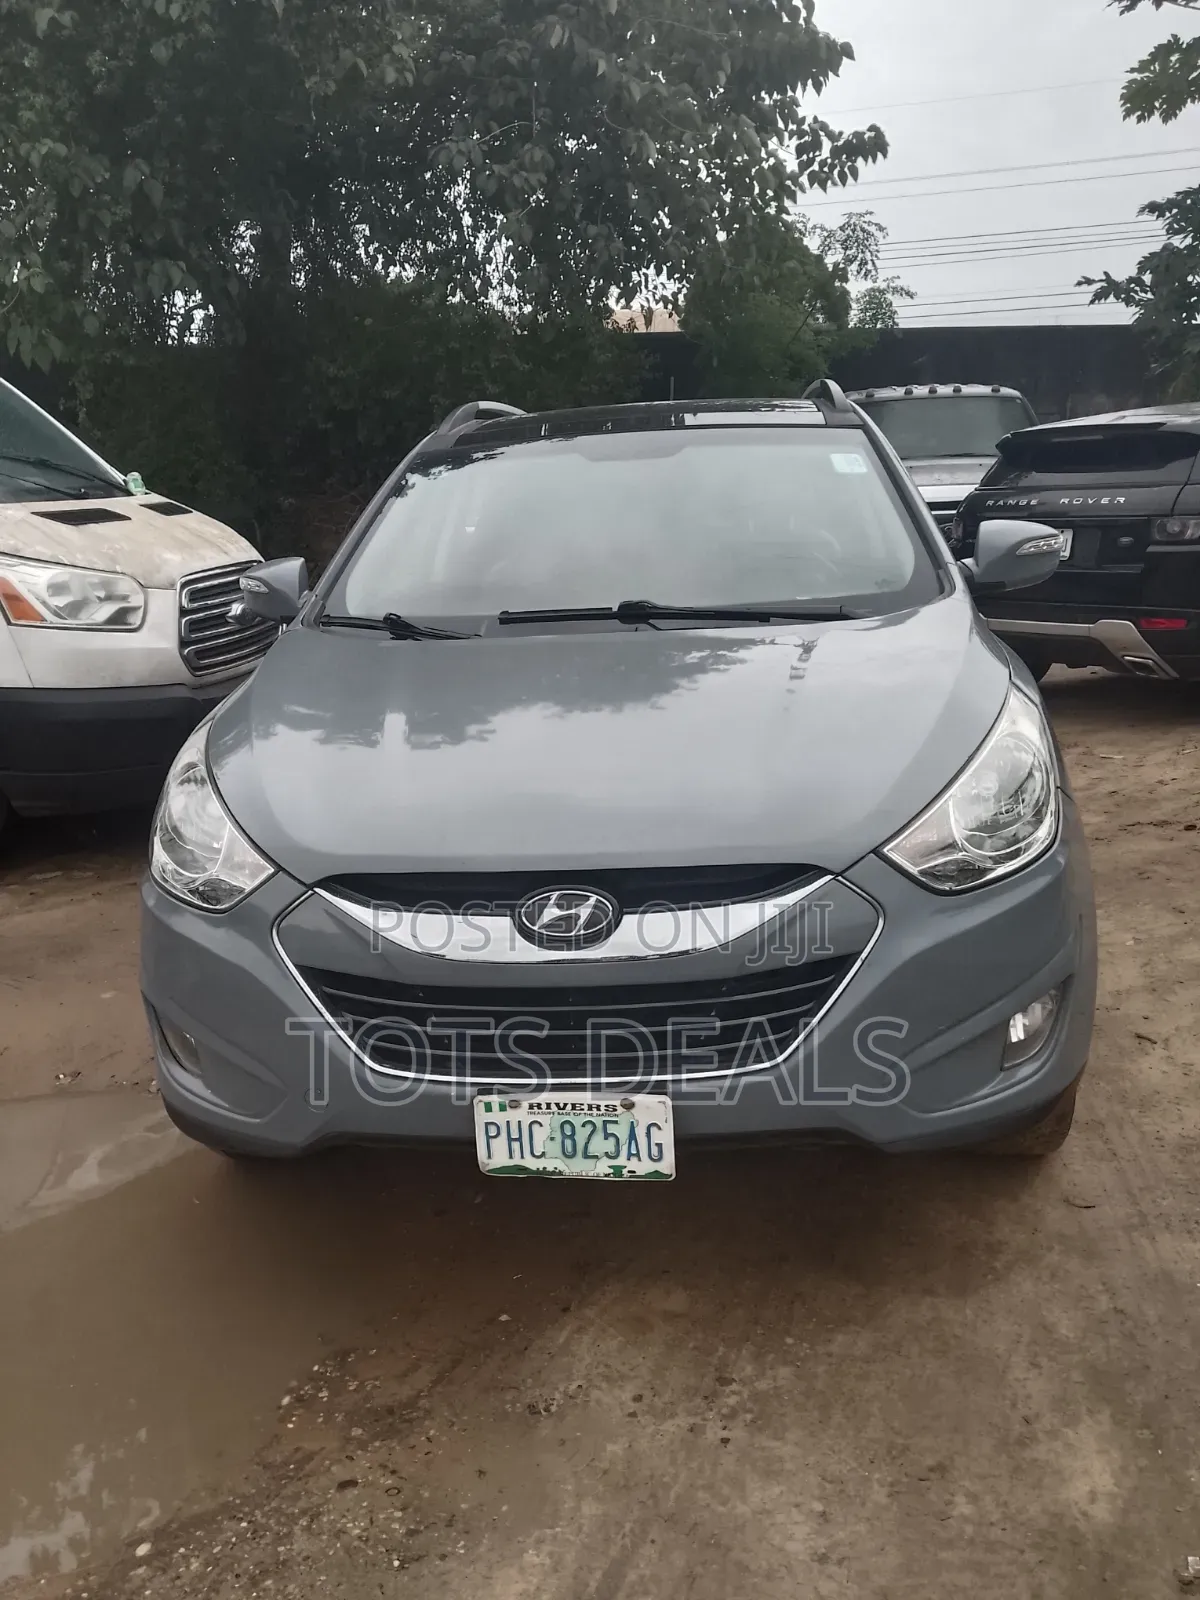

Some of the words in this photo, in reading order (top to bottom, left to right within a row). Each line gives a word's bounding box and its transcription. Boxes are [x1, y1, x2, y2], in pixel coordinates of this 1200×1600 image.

[985, 498, 1040, 507] RANGE
[1060, 497, 1126, 505] ROVER
[527, 1102, 618, 1112] RIVERS
[484, 1119, 546, 1160] PHC
[560, 1119, 664, 1162] 825AG
